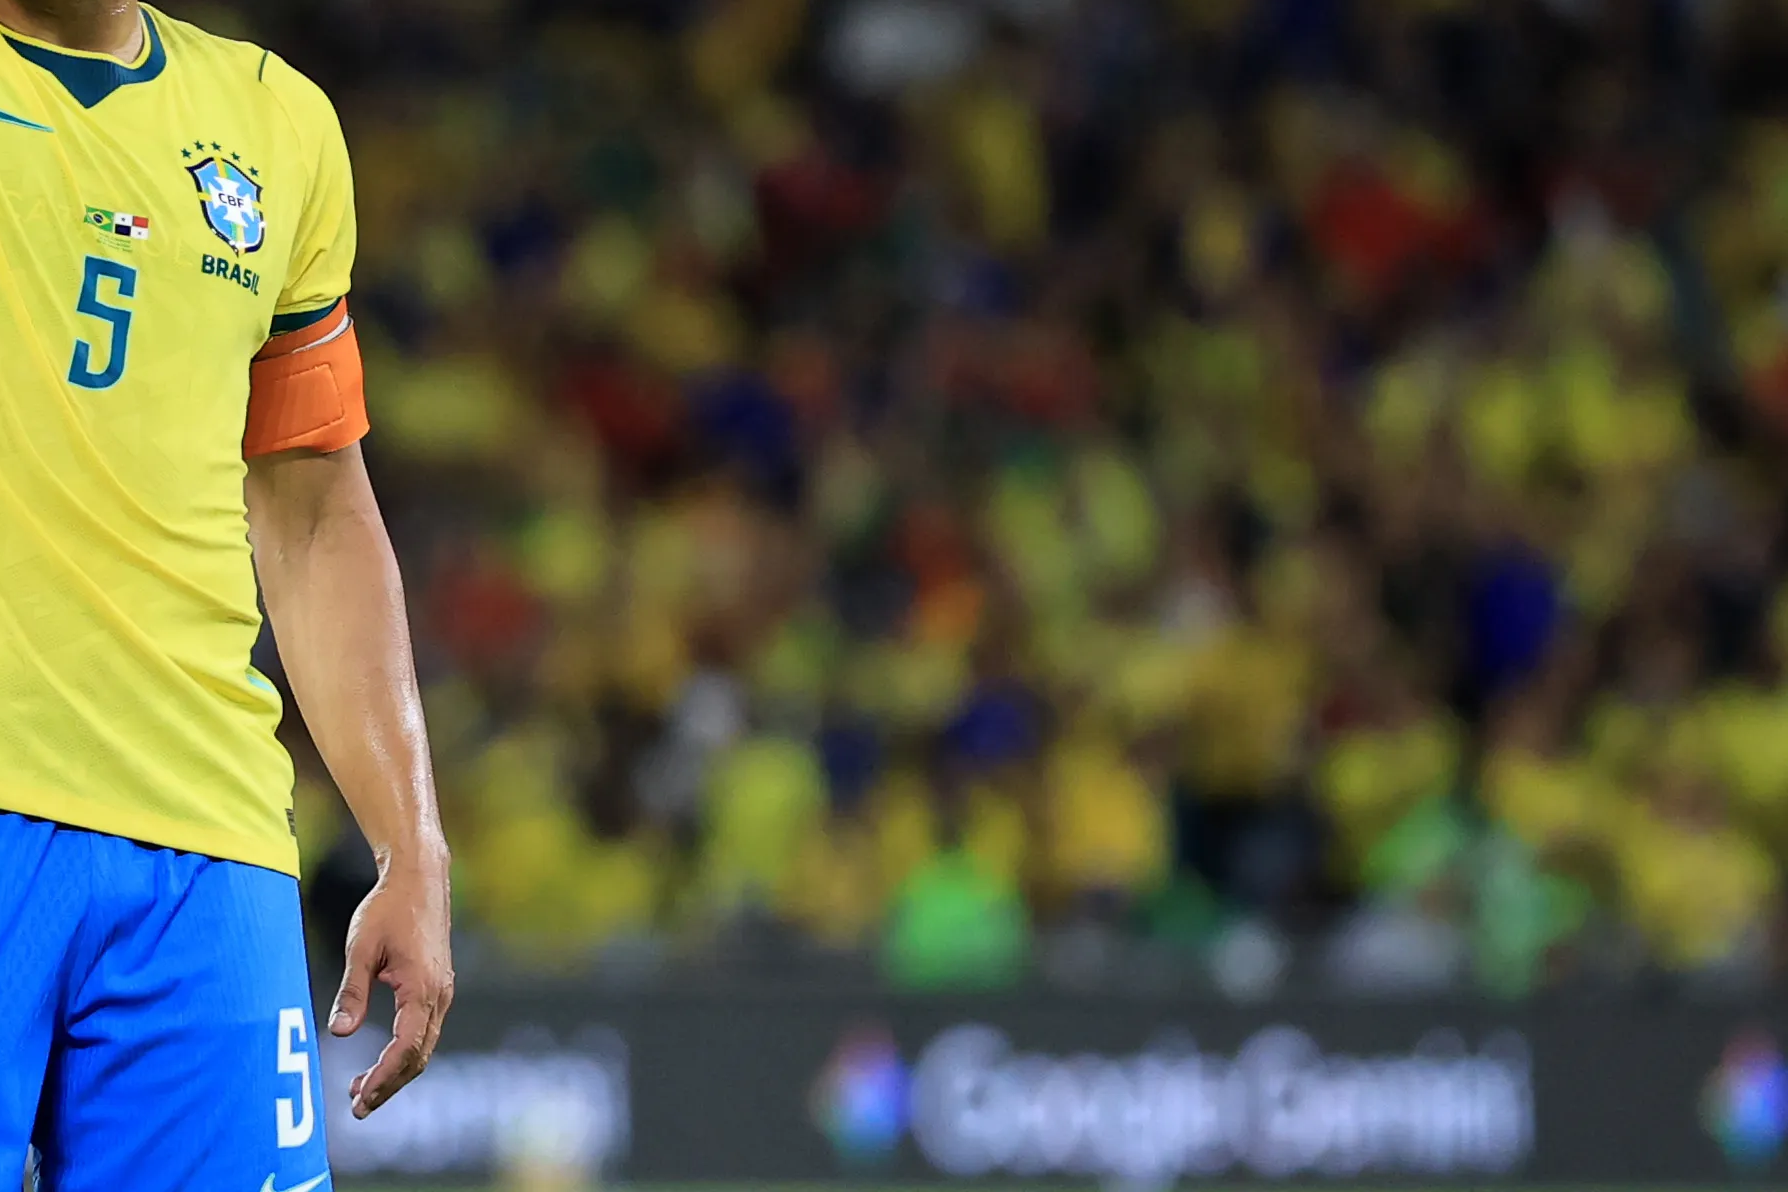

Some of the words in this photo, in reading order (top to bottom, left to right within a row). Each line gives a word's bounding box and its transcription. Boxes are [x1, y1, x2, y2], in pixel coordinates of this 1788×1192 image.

[218, 192, 244, 209] CBF
[201, 253, 260, 296] BRASIL
[67, 255, 137, 390] 5
[275, 1007, 315, 1149] 5
